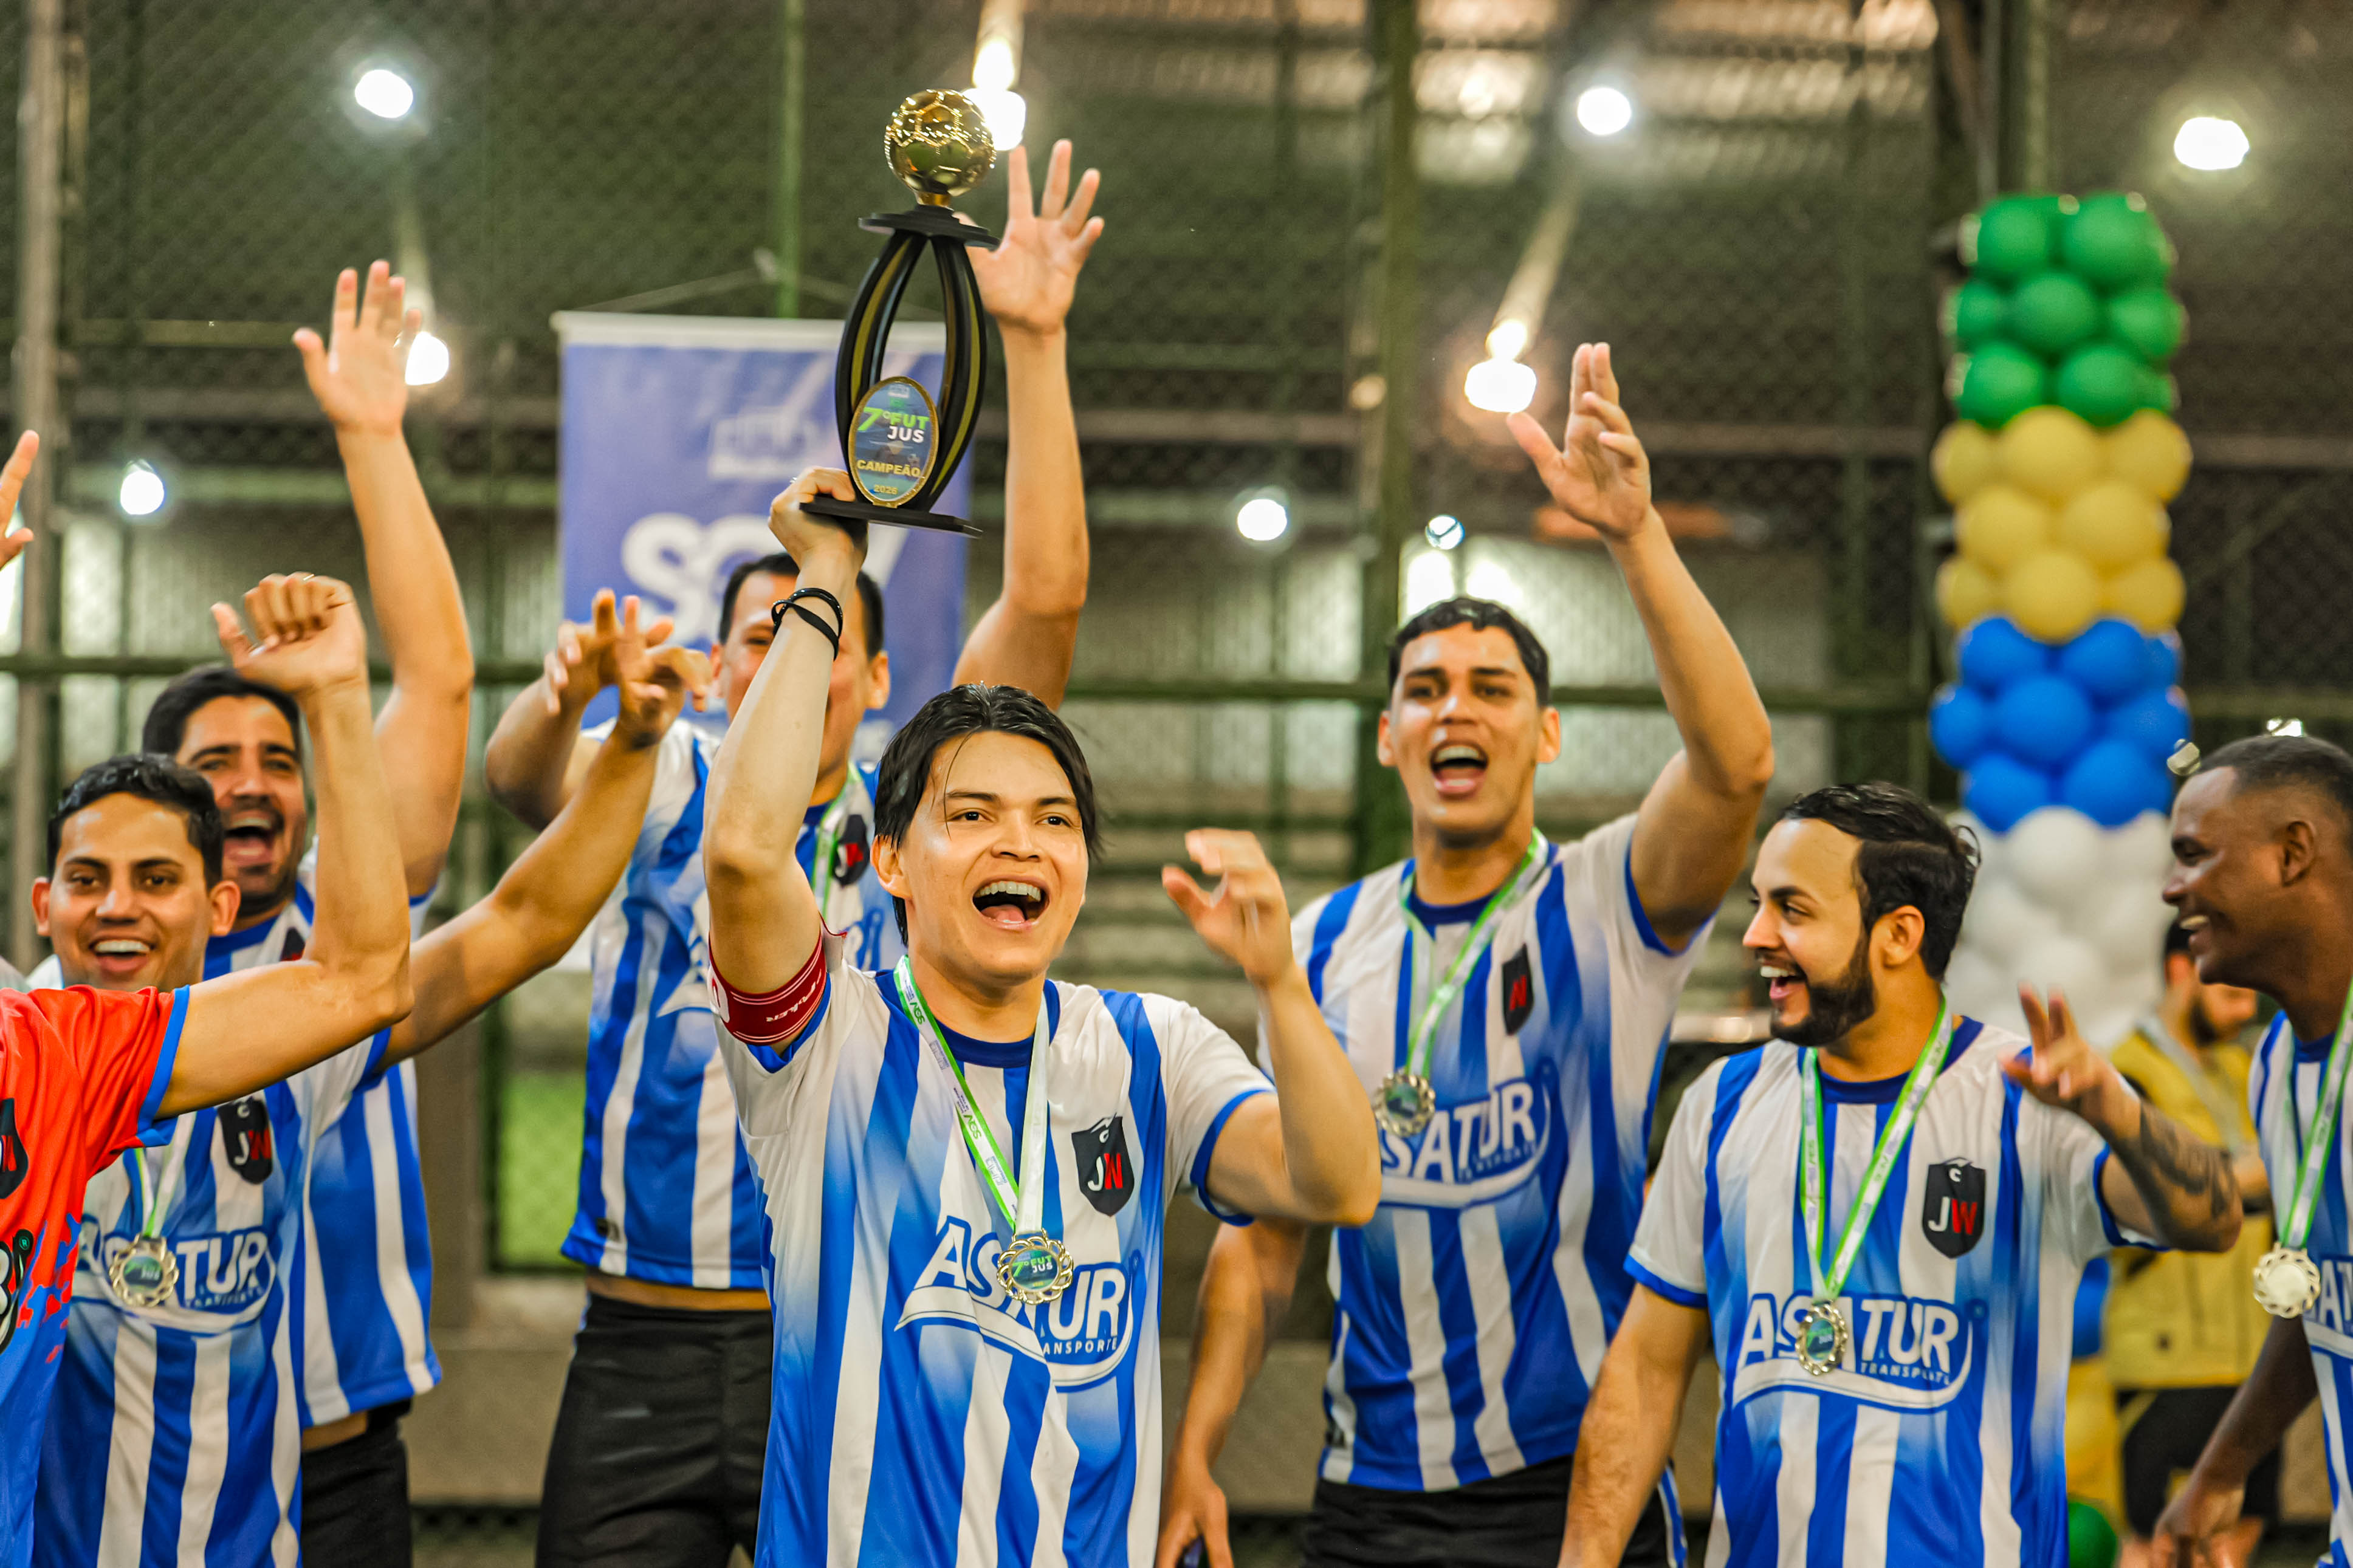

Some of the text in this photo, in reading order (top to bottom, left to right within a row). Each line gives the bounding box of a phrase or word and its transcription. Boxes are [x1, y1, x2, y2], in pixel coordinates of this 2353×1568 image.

[890, 413, 930, 430] FUT
[887, 426, 924, 443] JUS
[857, 459, 921, 477] CAMPEÃO
[1928, 1196, 1978, 1236] JW
[1031, 1255, 1052, 1267] FUT
[1032, 1262, 1053, 1274] JUS
[1043, 1338, 1118, 1355] ANSPORTE
